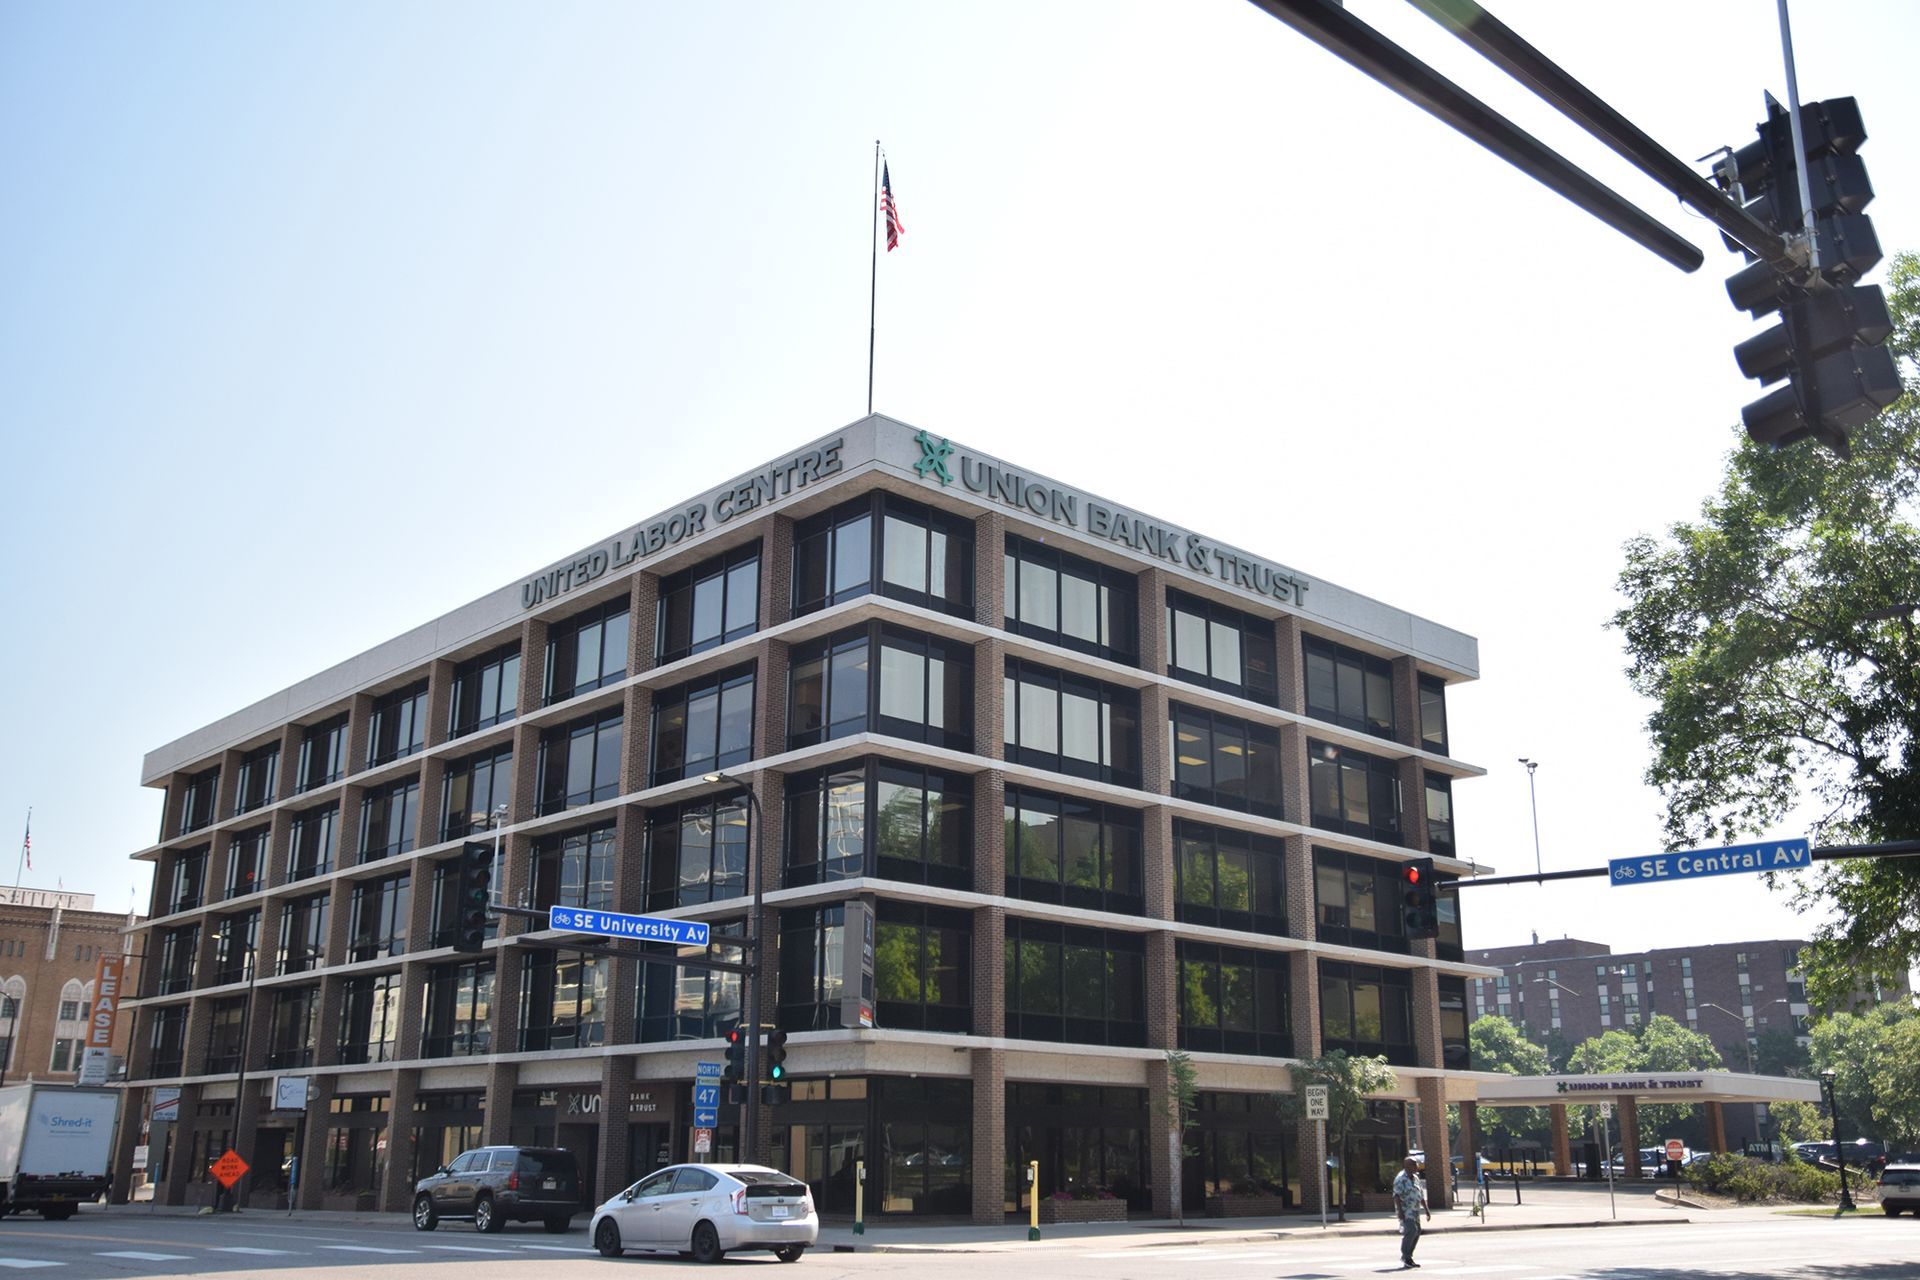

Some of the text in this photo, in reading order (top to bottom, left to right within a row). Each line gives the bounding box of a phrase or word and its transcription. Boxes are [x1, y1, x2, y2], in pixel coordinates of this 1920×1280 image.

[521, 437, 844, 609] UNITED LABOR CENTRE
[961, 455, 1310, 607] UNION BANK & TRUST
[1640, 846, 1804, 878] SE Central Av
[573, 913, 705, 941] SE University Av
[92, 965, 117, 1044] LEASE
[697, 1065, 720, 1075] NORTH
[1568, 1079, 1704, 1091] UNION BANK & TRUST
[630, 1093, 650, 1101] BANK
[698, 1089, 716, 1104] 47
[1307, 1088, 1326, 1097] BEGIN
[636, 1104, 657, 1112] TRUST
[1310, 1098, 1324, 1107] ONE
[1311, 1107, 1325, 1116] WAY
[50, 1115, 93, 1128] Shred-it
[1749, 1143, 1769, 1153] ATM
